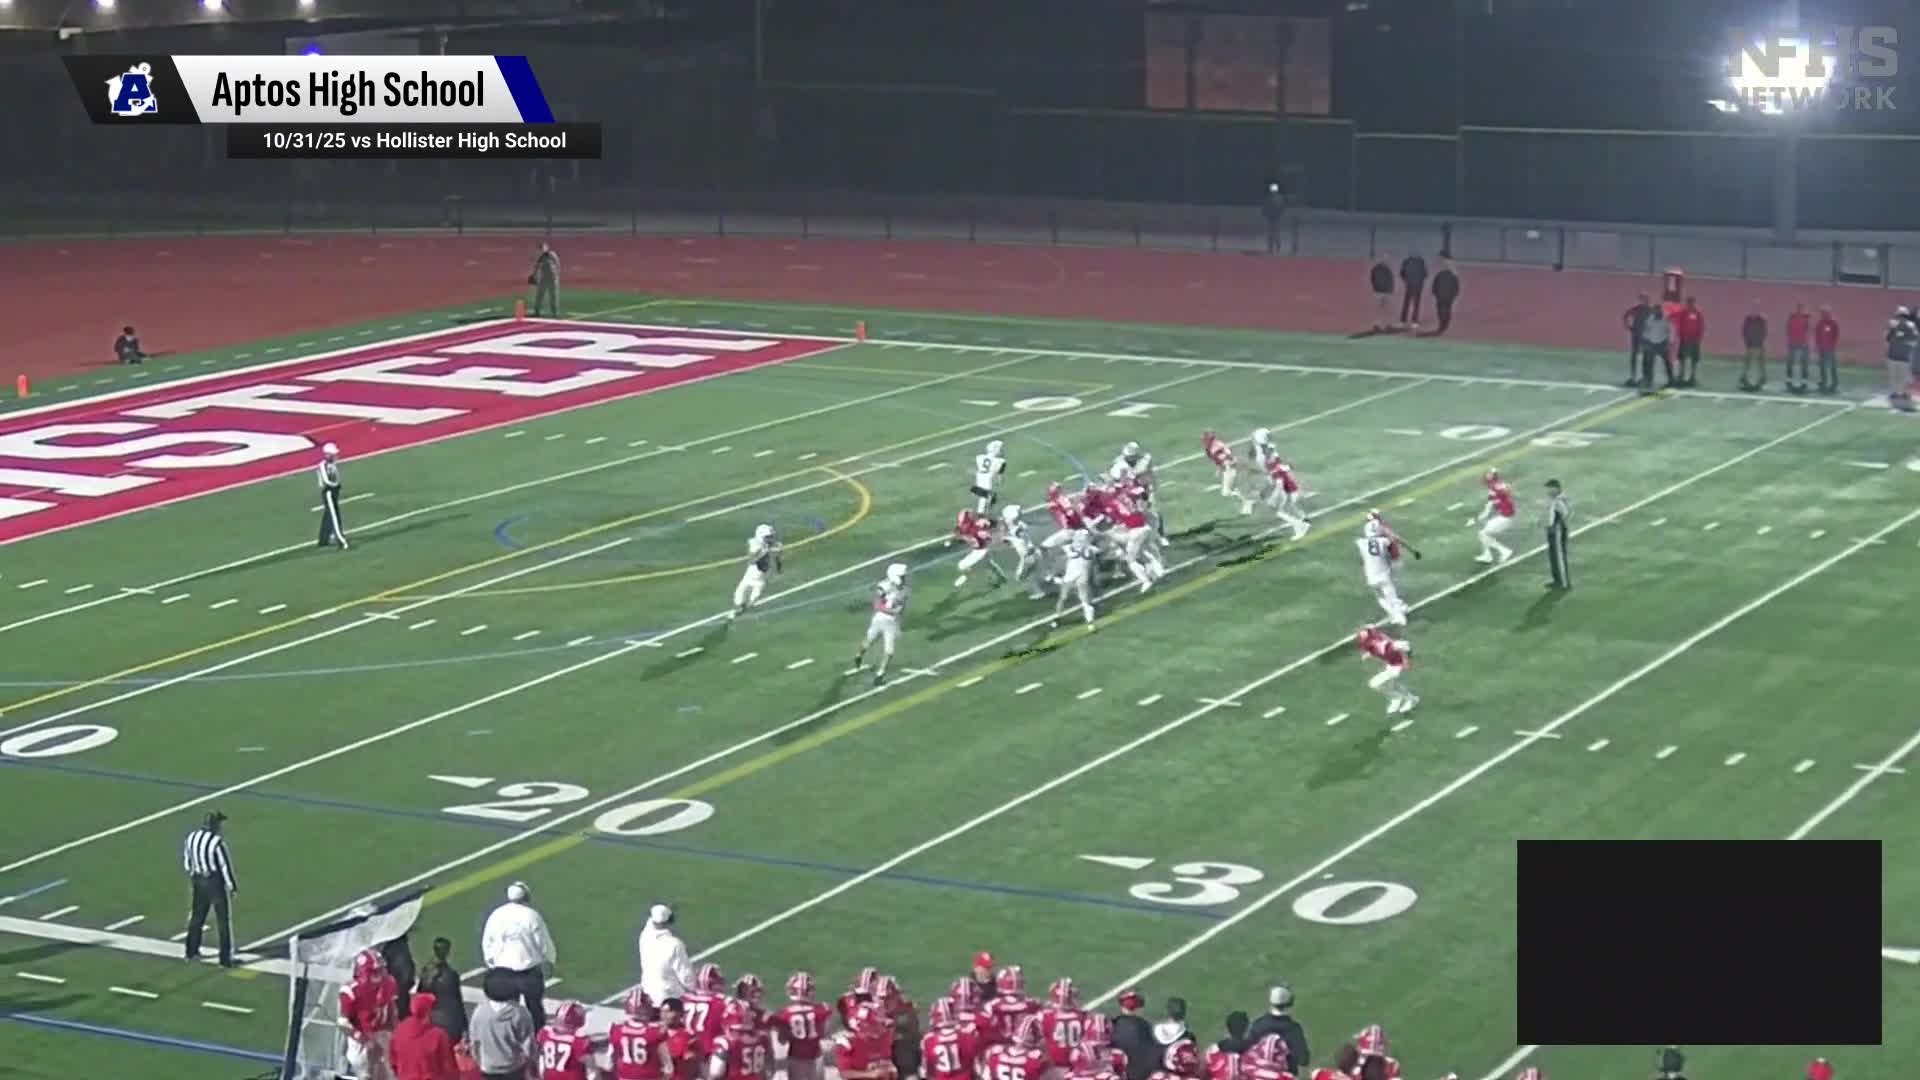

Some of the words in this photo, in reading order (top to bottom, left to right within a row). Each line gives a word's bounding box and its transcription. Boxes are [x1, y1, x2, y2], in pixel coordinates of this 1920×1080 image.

[982, 458, 991, 474] 9
[683, 1001, 709, 1035] 77
[1053, 1020, 1081, 1048] 40
[543, 1040, 572, 1072] 87
[620, 1036, 647, 1064] 16
[934, 1044, 961, 1072] 31
